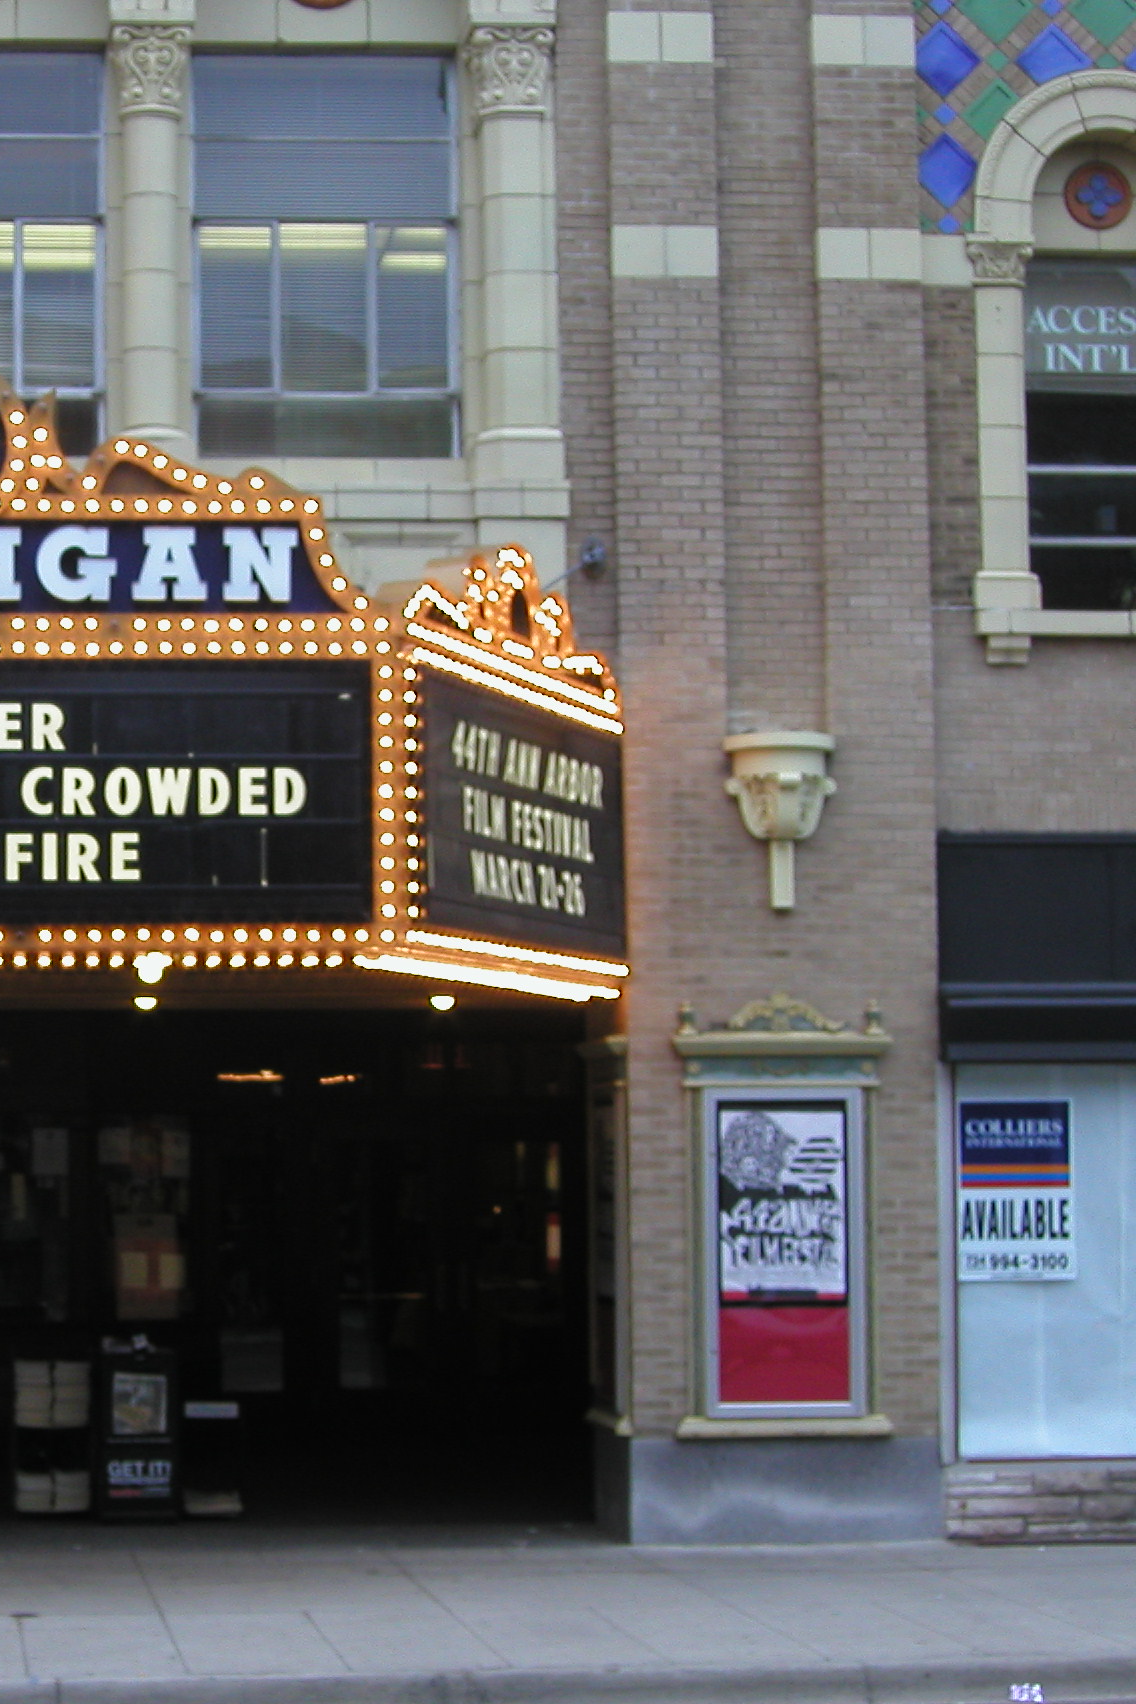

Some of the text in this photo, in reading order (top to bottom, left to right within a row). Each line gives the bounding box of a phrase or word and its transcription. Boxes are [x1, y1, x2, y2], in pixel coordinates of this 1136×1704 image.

[1045, 343, 1136, 373] INT'L
[452, 720, 604, 810] 44TH ANN ARBOR
[20, 766, 307, 817] CROWDED
[464, 785, 595, 864] FILM FESTIVAL
[5, 831, 141, 882] FIRE
[470, 849, 537, 905] MARCH
[965, 1118, 1063, 1136] COLLIERS
[962, 1199, 1070, 1240] AVAILABLE
[108, 1460, 145, 1478] GET
